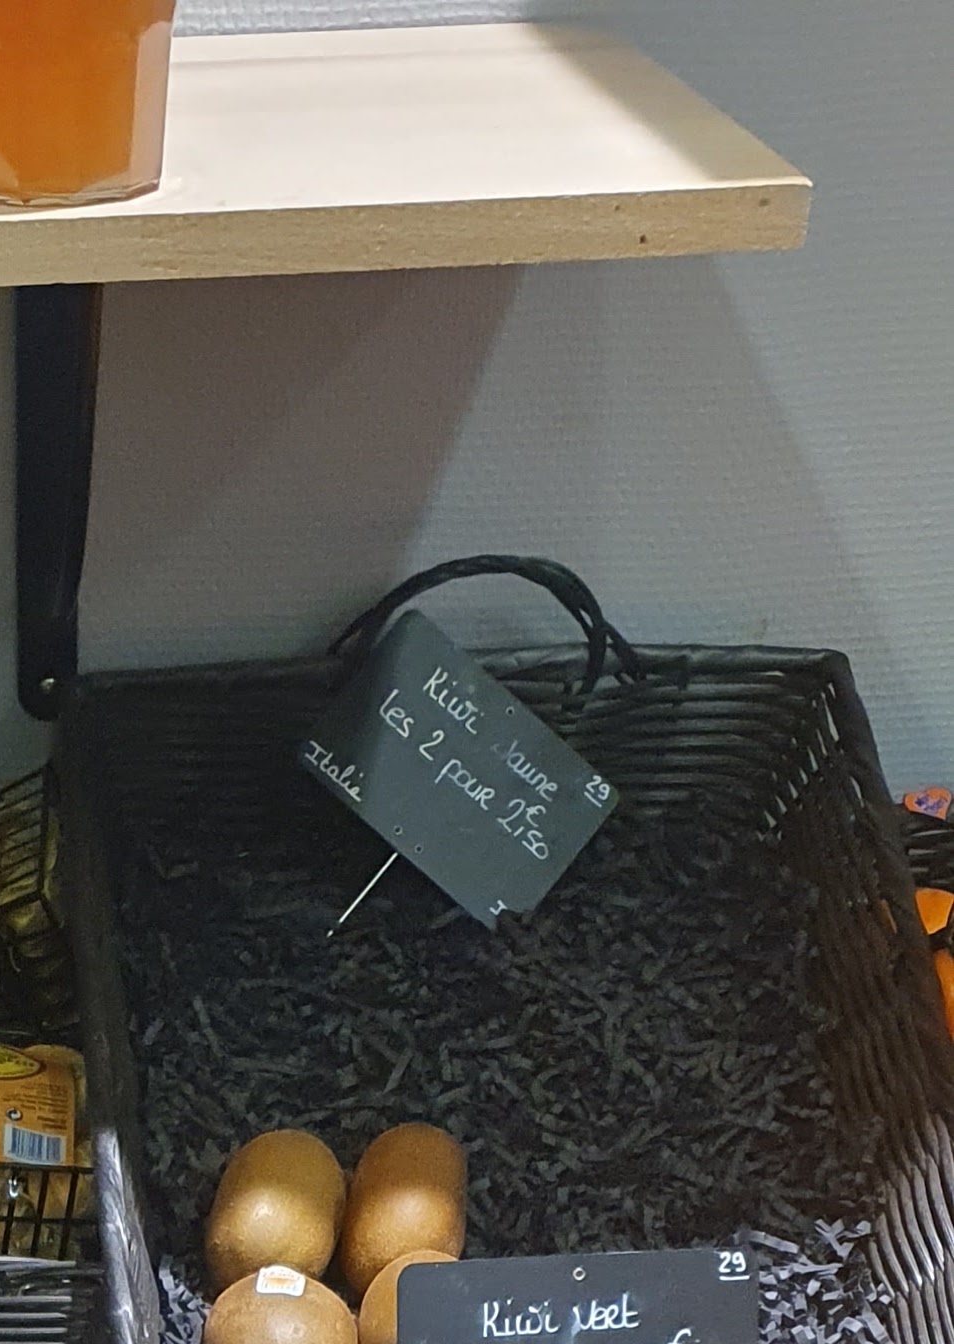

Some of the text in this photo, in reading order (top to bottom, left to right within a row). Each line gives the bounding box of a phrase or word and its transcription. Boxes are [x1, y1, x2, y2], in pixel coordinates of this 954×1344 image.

[421, 666, 479, 735] Kiwi
[418, 729, 445, 762] 2
[304, 739, 367, 803] Italie
[584, 774, 612, 803] 29
[718, 1251, 748, 1275] 29
[482, 1297, 560, 1338] Kiwi
